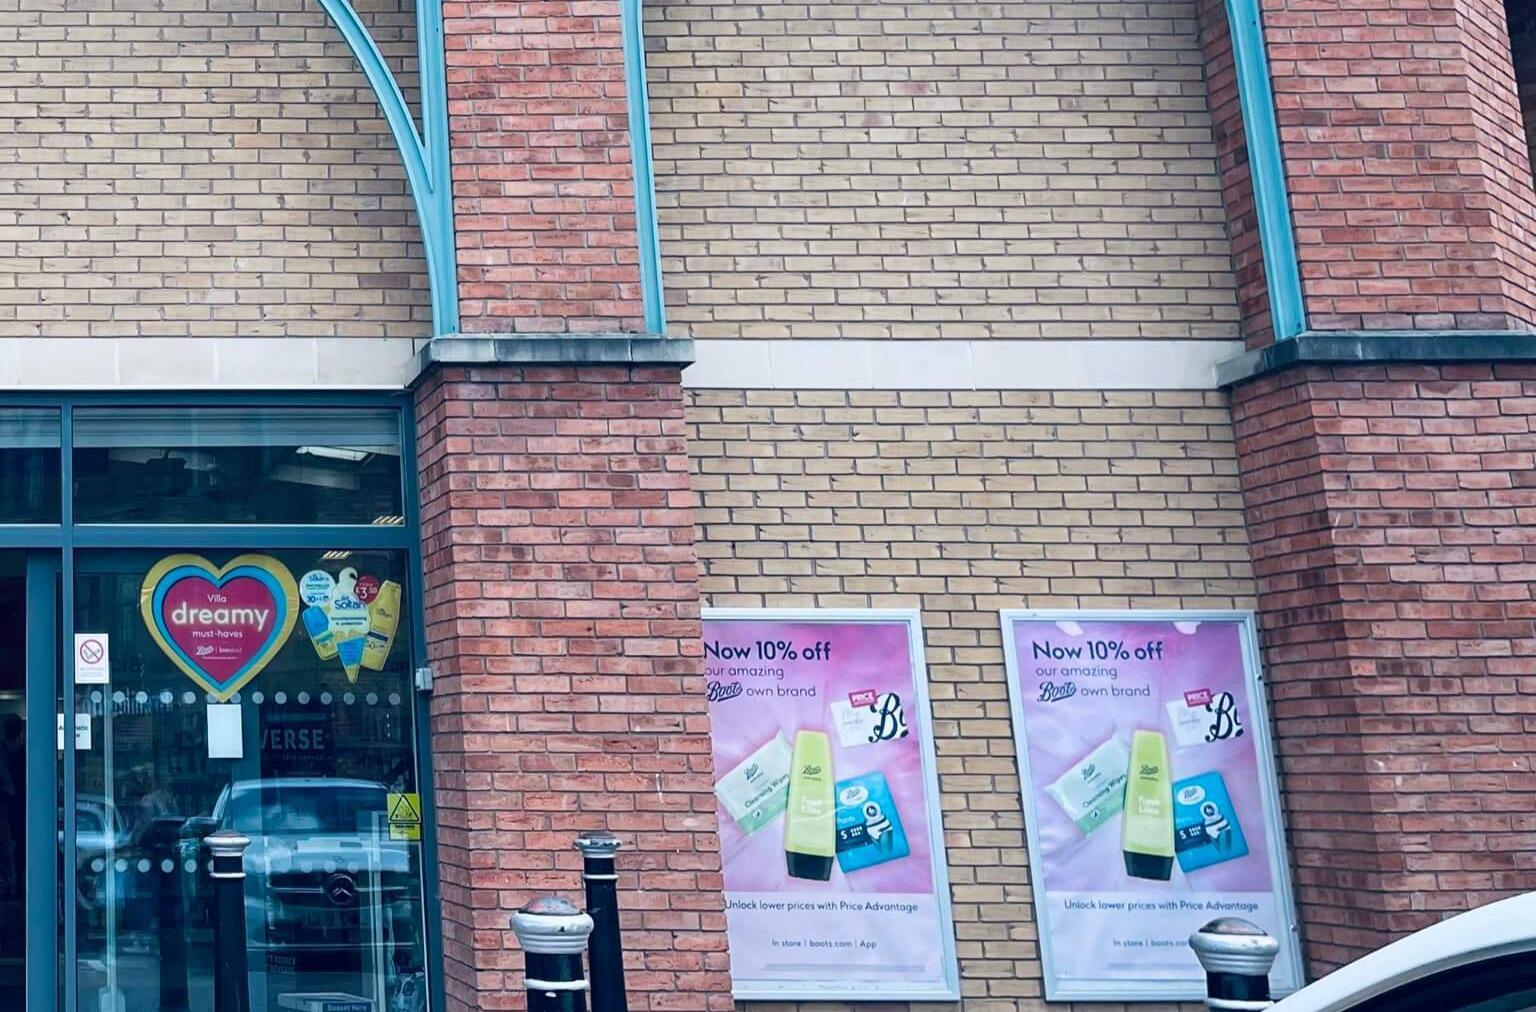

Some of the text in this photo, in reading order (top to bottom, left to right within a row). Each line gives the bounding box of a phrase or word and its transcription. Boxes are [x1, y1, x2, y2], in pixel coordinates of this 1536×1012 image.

[207, 594, 227, 603] Villa
[171, 601, 269, 632] dreamy
[192, 629, 243, 638] must-haves
[704, 640, 831, 660] Now 10% off
[1032, 640, 1163, 660] Now 10% off
[704, 666, 784, 680] our amazing
[1036, 666, 1118, 680] our amazing
[707, 680, 816, 702] Boots own brand
[1037, 681, 1151, 702] Boots own brand
[725, 900, 919, 914] Unlock lower prices with Price Advantage
[1064, 900, 1259, 913] Unlock lower prices with Price Advantage
[859, 940, 878, 949] App
